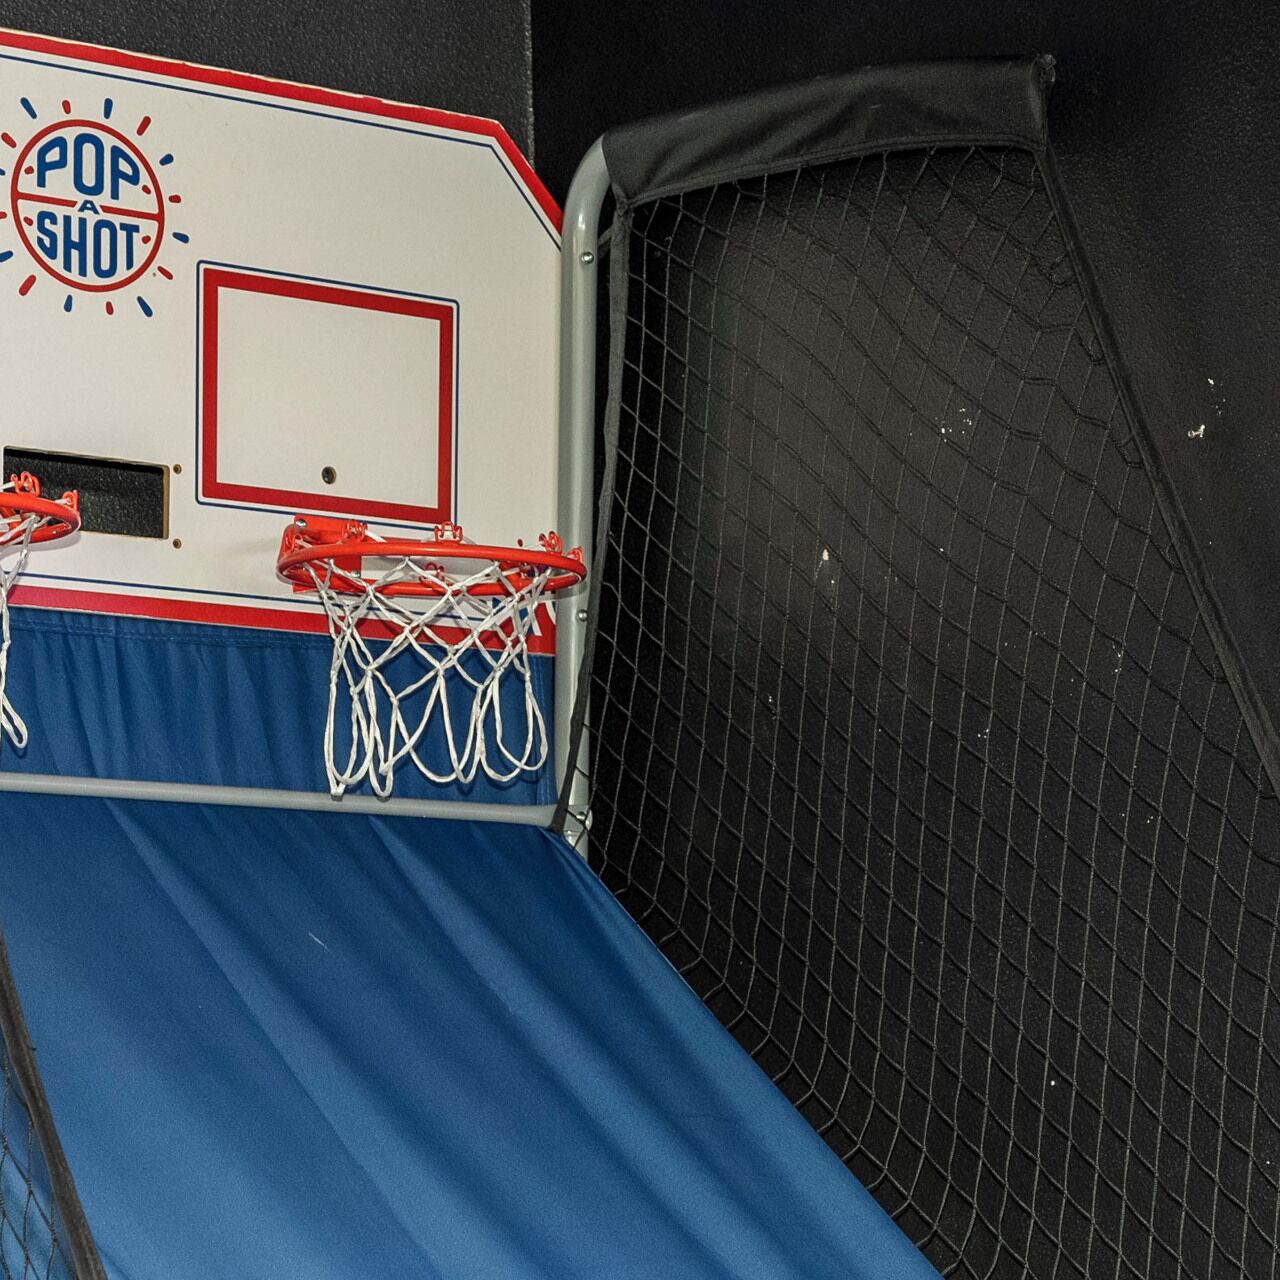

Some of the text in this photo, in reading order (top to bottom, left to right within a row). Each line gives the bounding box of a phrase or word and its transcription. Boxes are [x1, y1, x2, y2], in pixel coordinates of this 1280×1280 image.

[36, 132, 141, 201] POP
[78, 199, 100, 215] A
[36, 210, 140, 279] SHOT
